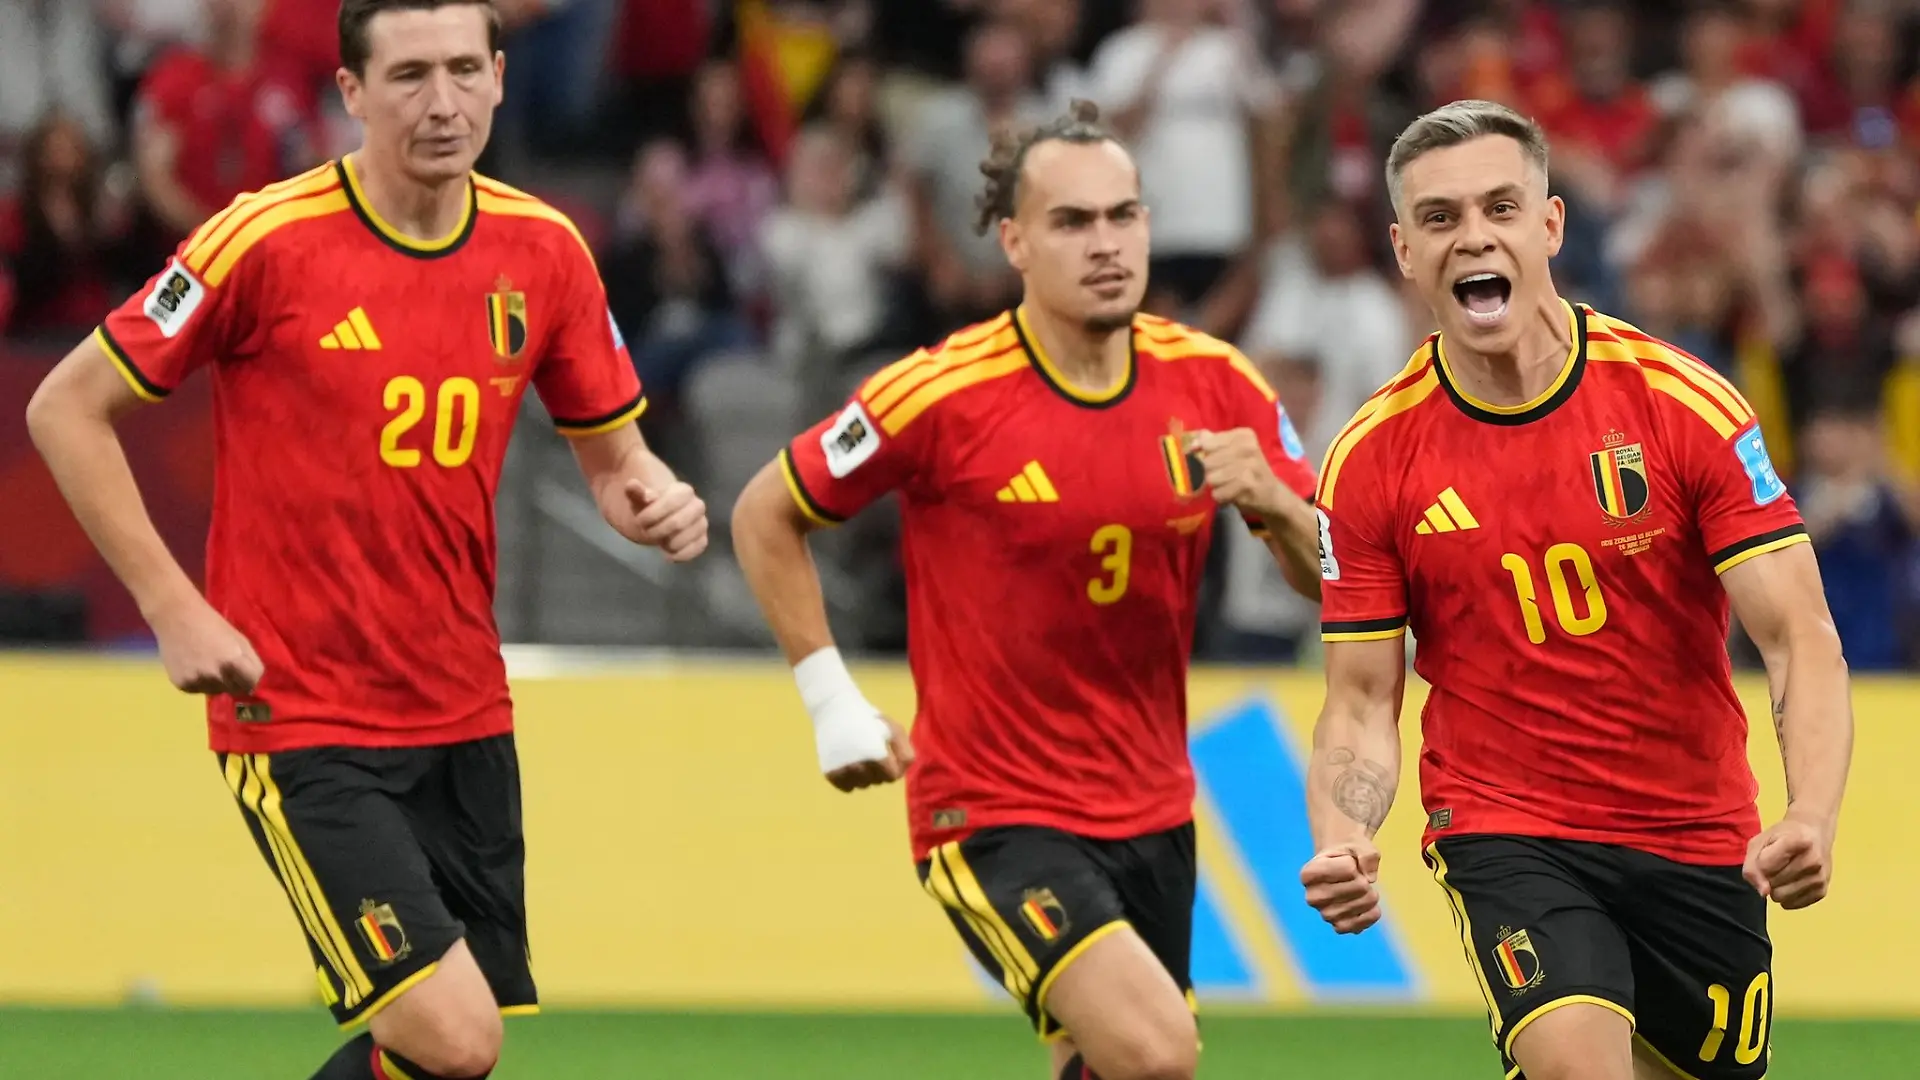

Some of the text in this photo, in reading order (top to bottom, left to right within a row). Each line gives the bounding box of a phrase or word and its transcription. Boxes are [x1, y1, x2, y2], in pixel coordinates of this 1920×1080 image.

[380, 375, 480, 468] 20
[1087, 524, 1133, 606] 3
[1501, 542, 1608, 645] 10
[1699, 971, 1769, 1065] 10
